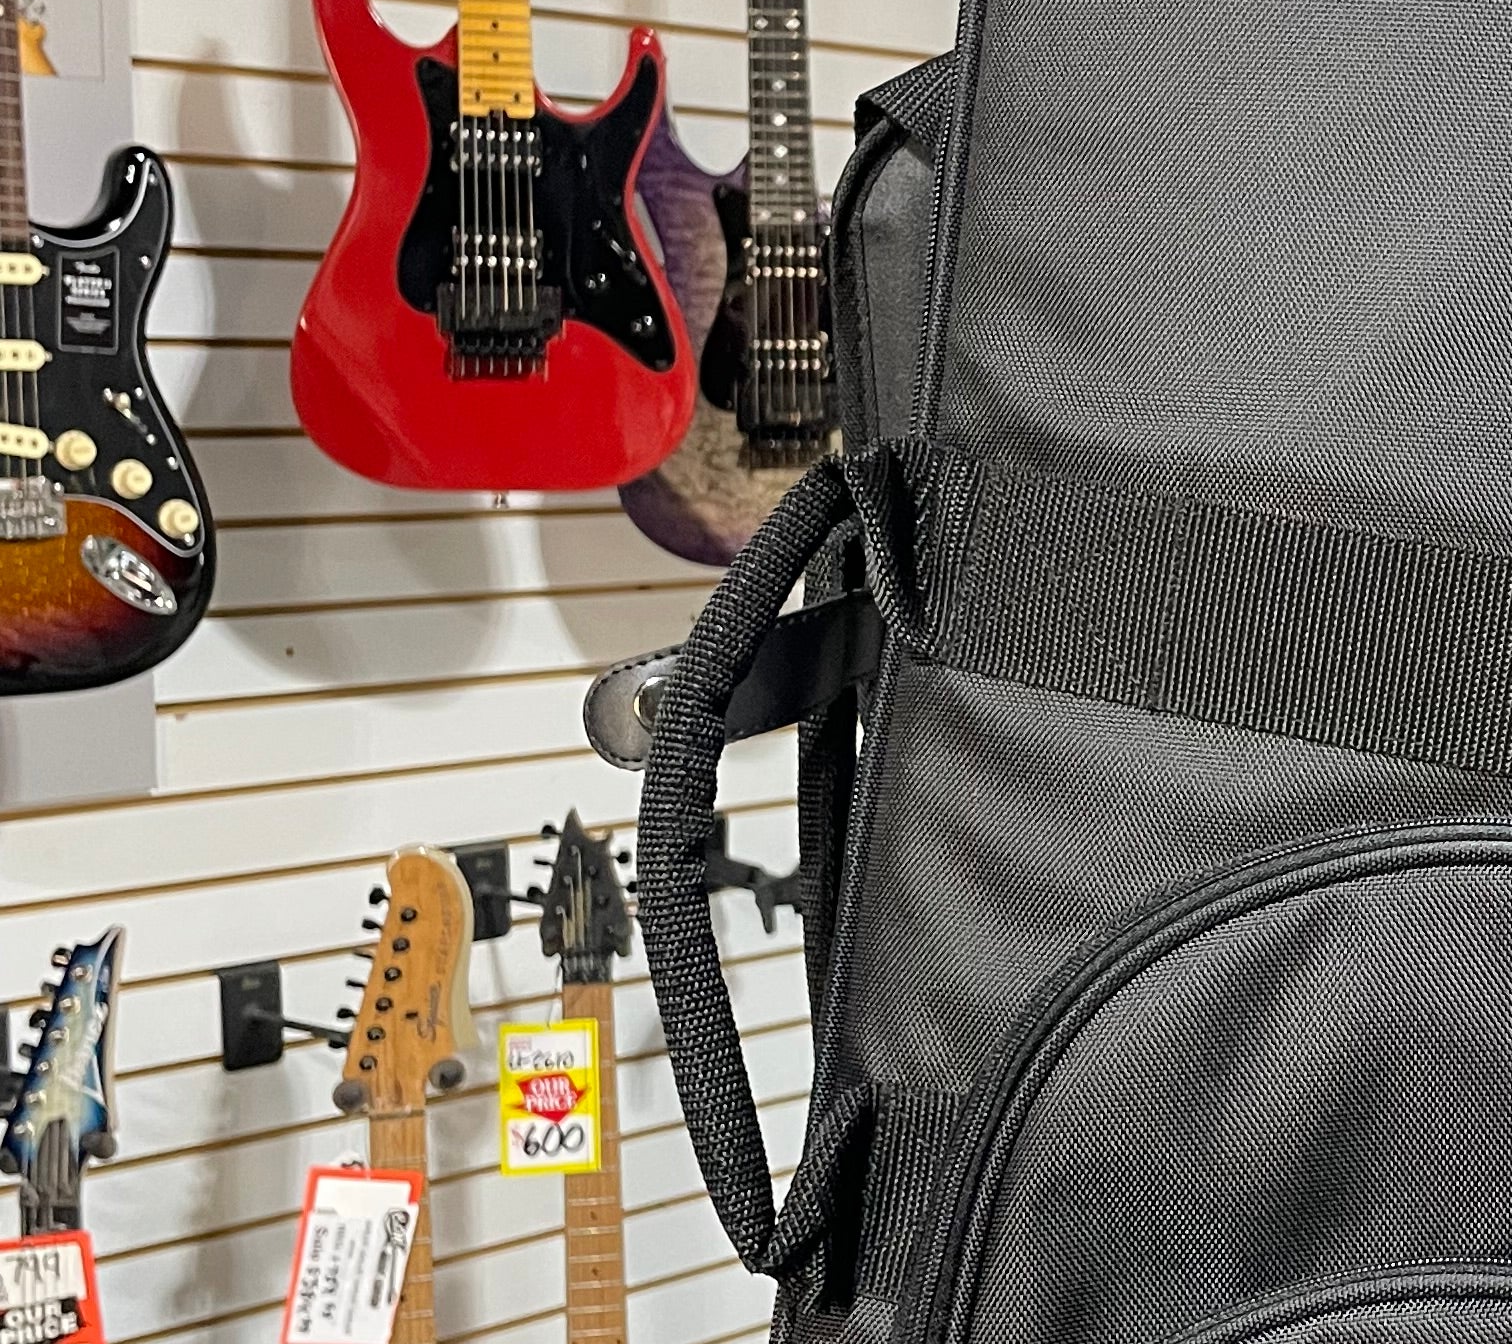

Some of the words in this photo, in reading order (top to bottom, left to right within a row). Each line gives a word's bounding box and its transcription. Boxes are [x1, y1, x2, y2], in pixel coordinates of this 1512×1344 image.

[529, 1077, 570, 1097] OUR
[525, 1090, 578, 1112] PRICE
[4, 1301, 62, 1331] OUR
